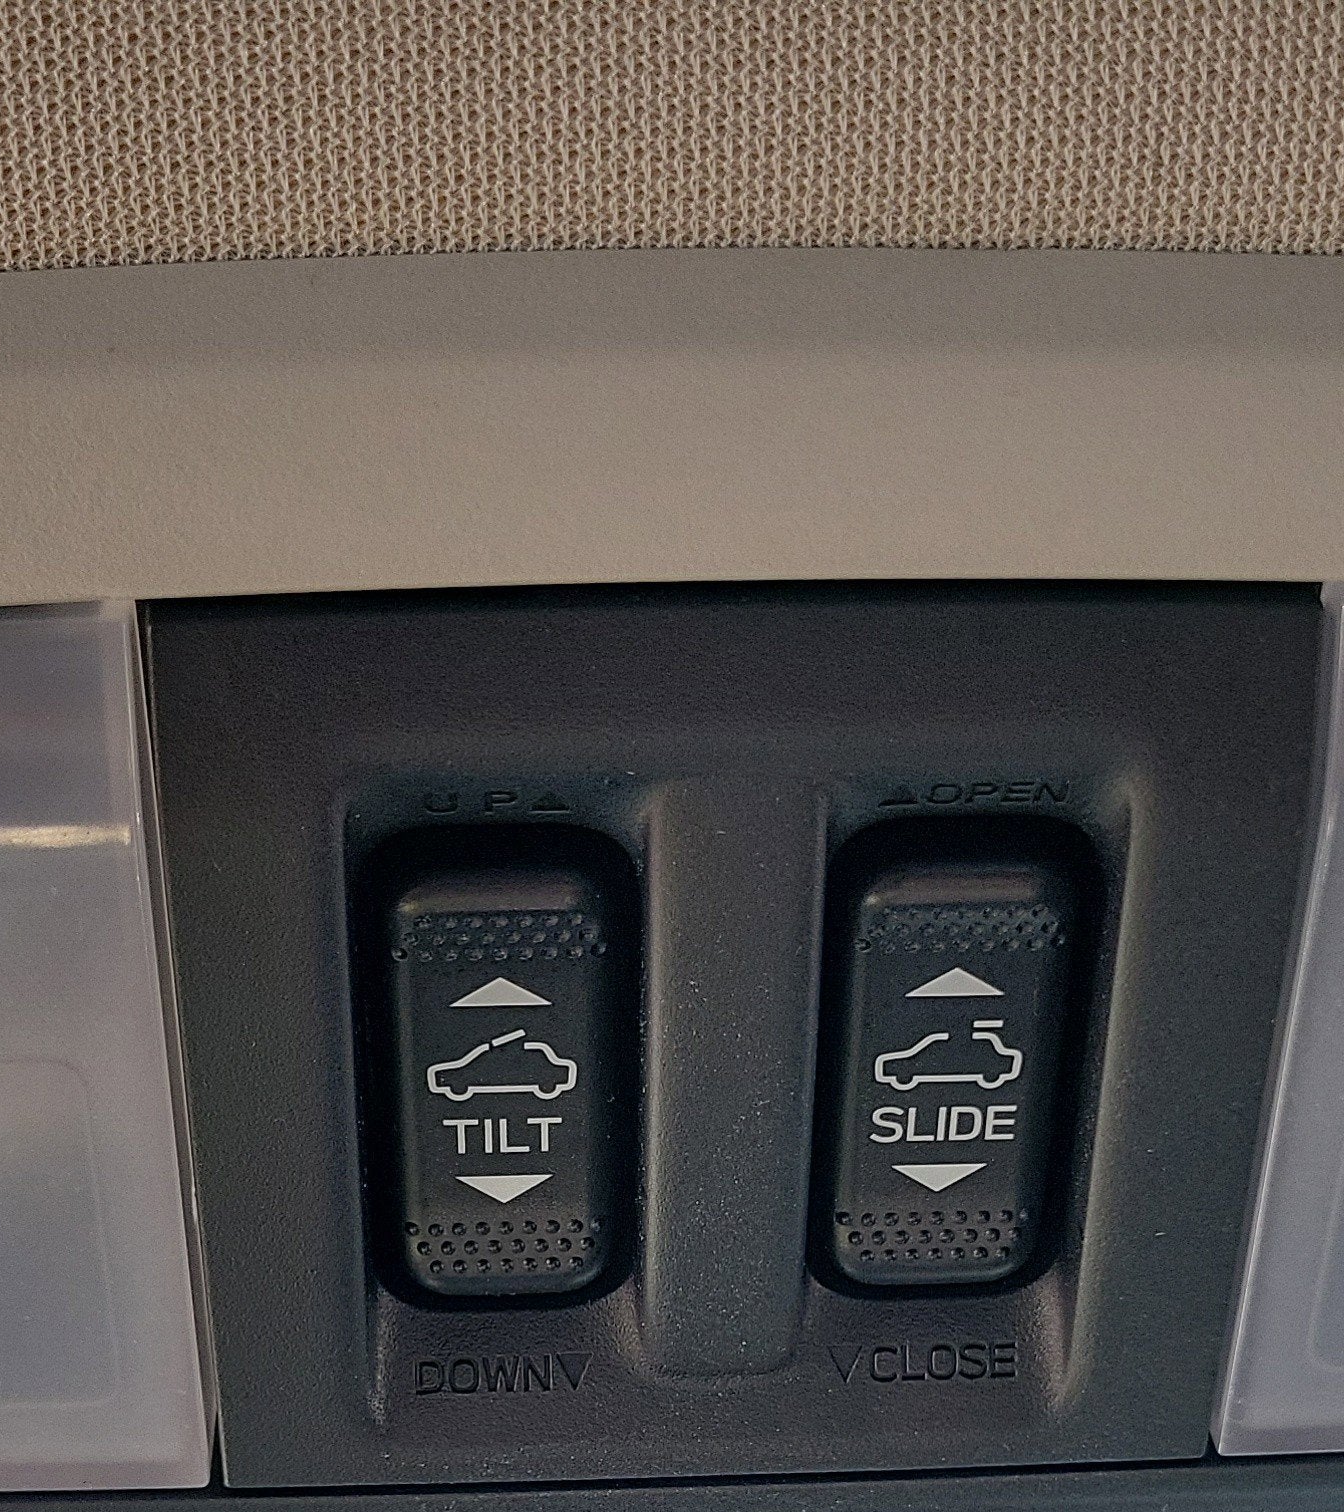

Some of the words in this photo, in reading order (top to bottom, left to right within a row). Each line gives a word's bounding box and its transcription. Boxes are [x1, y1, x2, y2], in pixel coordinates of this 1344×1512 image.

[924, 780, 1070, 805] OPEN
[442, 1116, 563, 1155] TILT
[868, 1104, 1019, 1144] SLIDE
[414, 1353, 551, 1395] DOWN
[870, 1342, 1017, 1383] CLOSE
